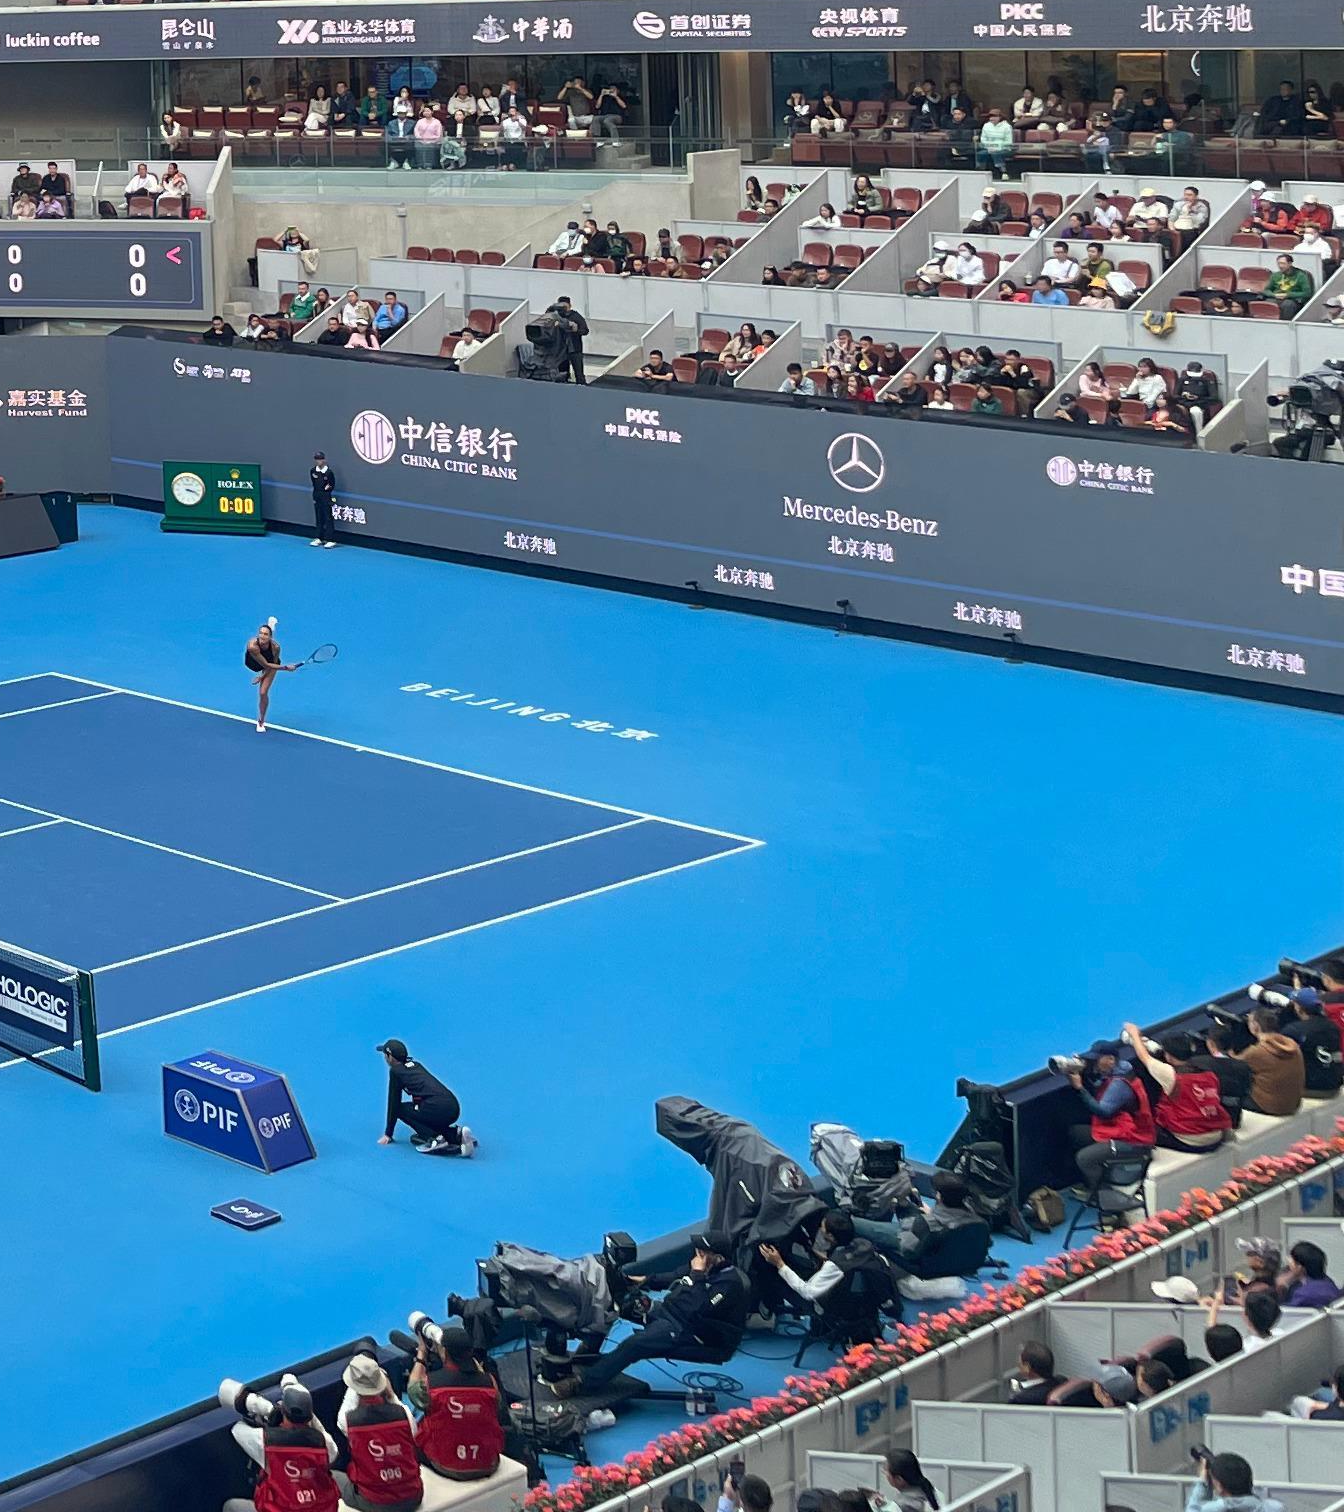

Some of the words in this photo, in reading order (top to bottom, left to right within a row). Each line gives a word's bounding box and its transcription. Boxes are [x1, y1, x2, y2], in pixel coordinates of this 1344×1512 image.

[669, 14, 751, 30] 首创证券
[819, 7, 900, 25] 央视体育
[1000, 2, 1044, 20] PICC
[1140, 3, 1254, 33] 北京奔驰
[162, 19, 214, 40] 昆仑山
[321, 18, 416, 36] 鑫业永华体育
[844, 26, 908, 37] SPORTS
[973, 23, 1073, 38] 中国人民保险
[5, 32, 50, 48] luckin
[53, 31, 100, 47] coffee
[7, 244, 22, 264] 0
[128, 244, 146, 268] 0
[8, 272, 23, 293] 0
[129, 272, 147, 297] 0
[7, 389, 87, 407] 嘉实基金
[7, 408, 54, 417] Harvest
[57, 408, 88, 417] Fund
[625, 407, 660, 426] PICC
[398, 416, 518, 463] 中信银行
[604, 422, 682, 444] 中国人民保险
[401, 453, 442, 470] CHINA
[444, 459, 478, 475] CITIC
[481, 464, 518, 481] BANK
[1077, 459, 1155, 485] 中信银行
[217, 480, 254, 490] ROLEX
[219, 496, 254, 514] 0:00
[782, 496, 938, 537] Mercedes-Benz
[503, 531, 557, 555] 北京奔驰
[827, 535, 895, 563] 北京奔驰
[713, 564, 775, 591] 北京奔驰
[952, 601, 1023, 630] 北京奔驰
[1226, 643, 1306, 675] 北京奔驰
[399, 682, 571, 723] BEIJING
[203, 1100, 238, 1133] PIF
[272, 1113, 292, 1132] PIF
